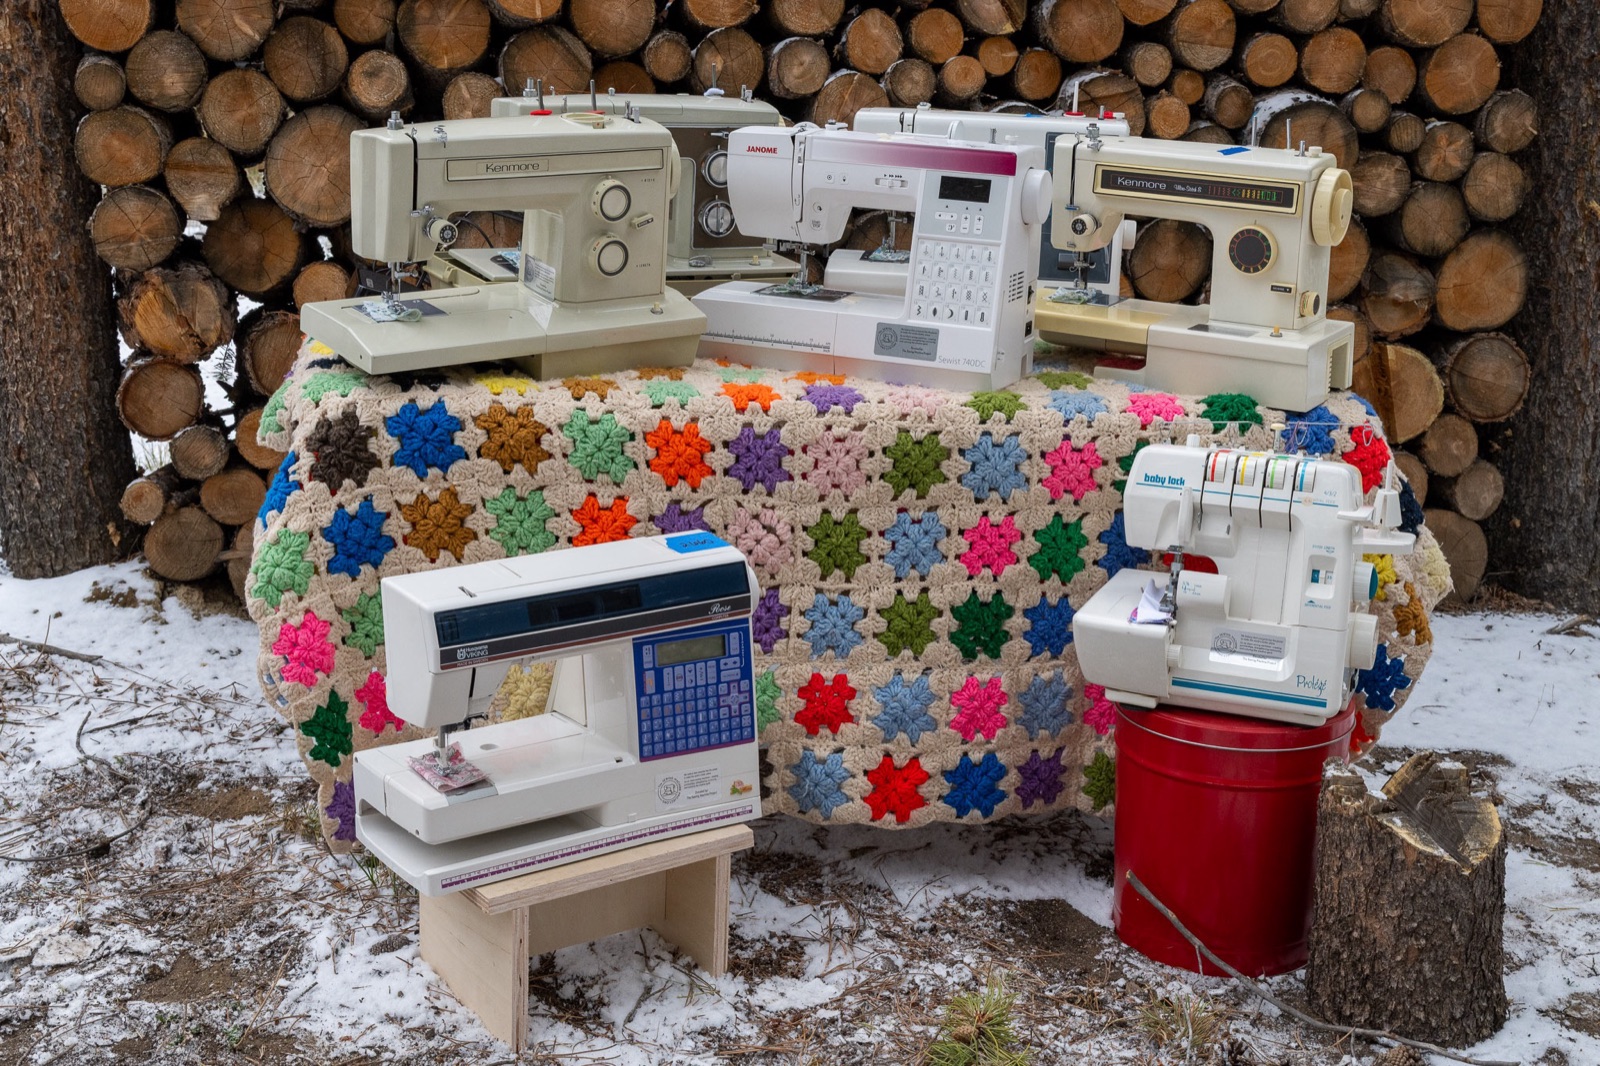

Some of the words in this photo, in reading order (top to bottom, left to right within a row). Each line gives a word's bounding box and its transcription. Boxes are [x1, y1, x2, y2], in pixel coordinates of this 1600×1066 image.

[746, 145, 778, 154] JANOME
[485, 162, 540, 173] Kenmore
[1117, 176, 1167, 190] Kenmore
[938, 355, 960, 365] Sewist
[962, 358, 987, 368] 740DC
[1143, 472, 1166, 486] baby
[1167, 475, 1185, 486] lock
[708, 602, 732, 615] Rose
[465, 644, 488, 652] Husqvarna
[466, 649, 488, 659] VIKING
